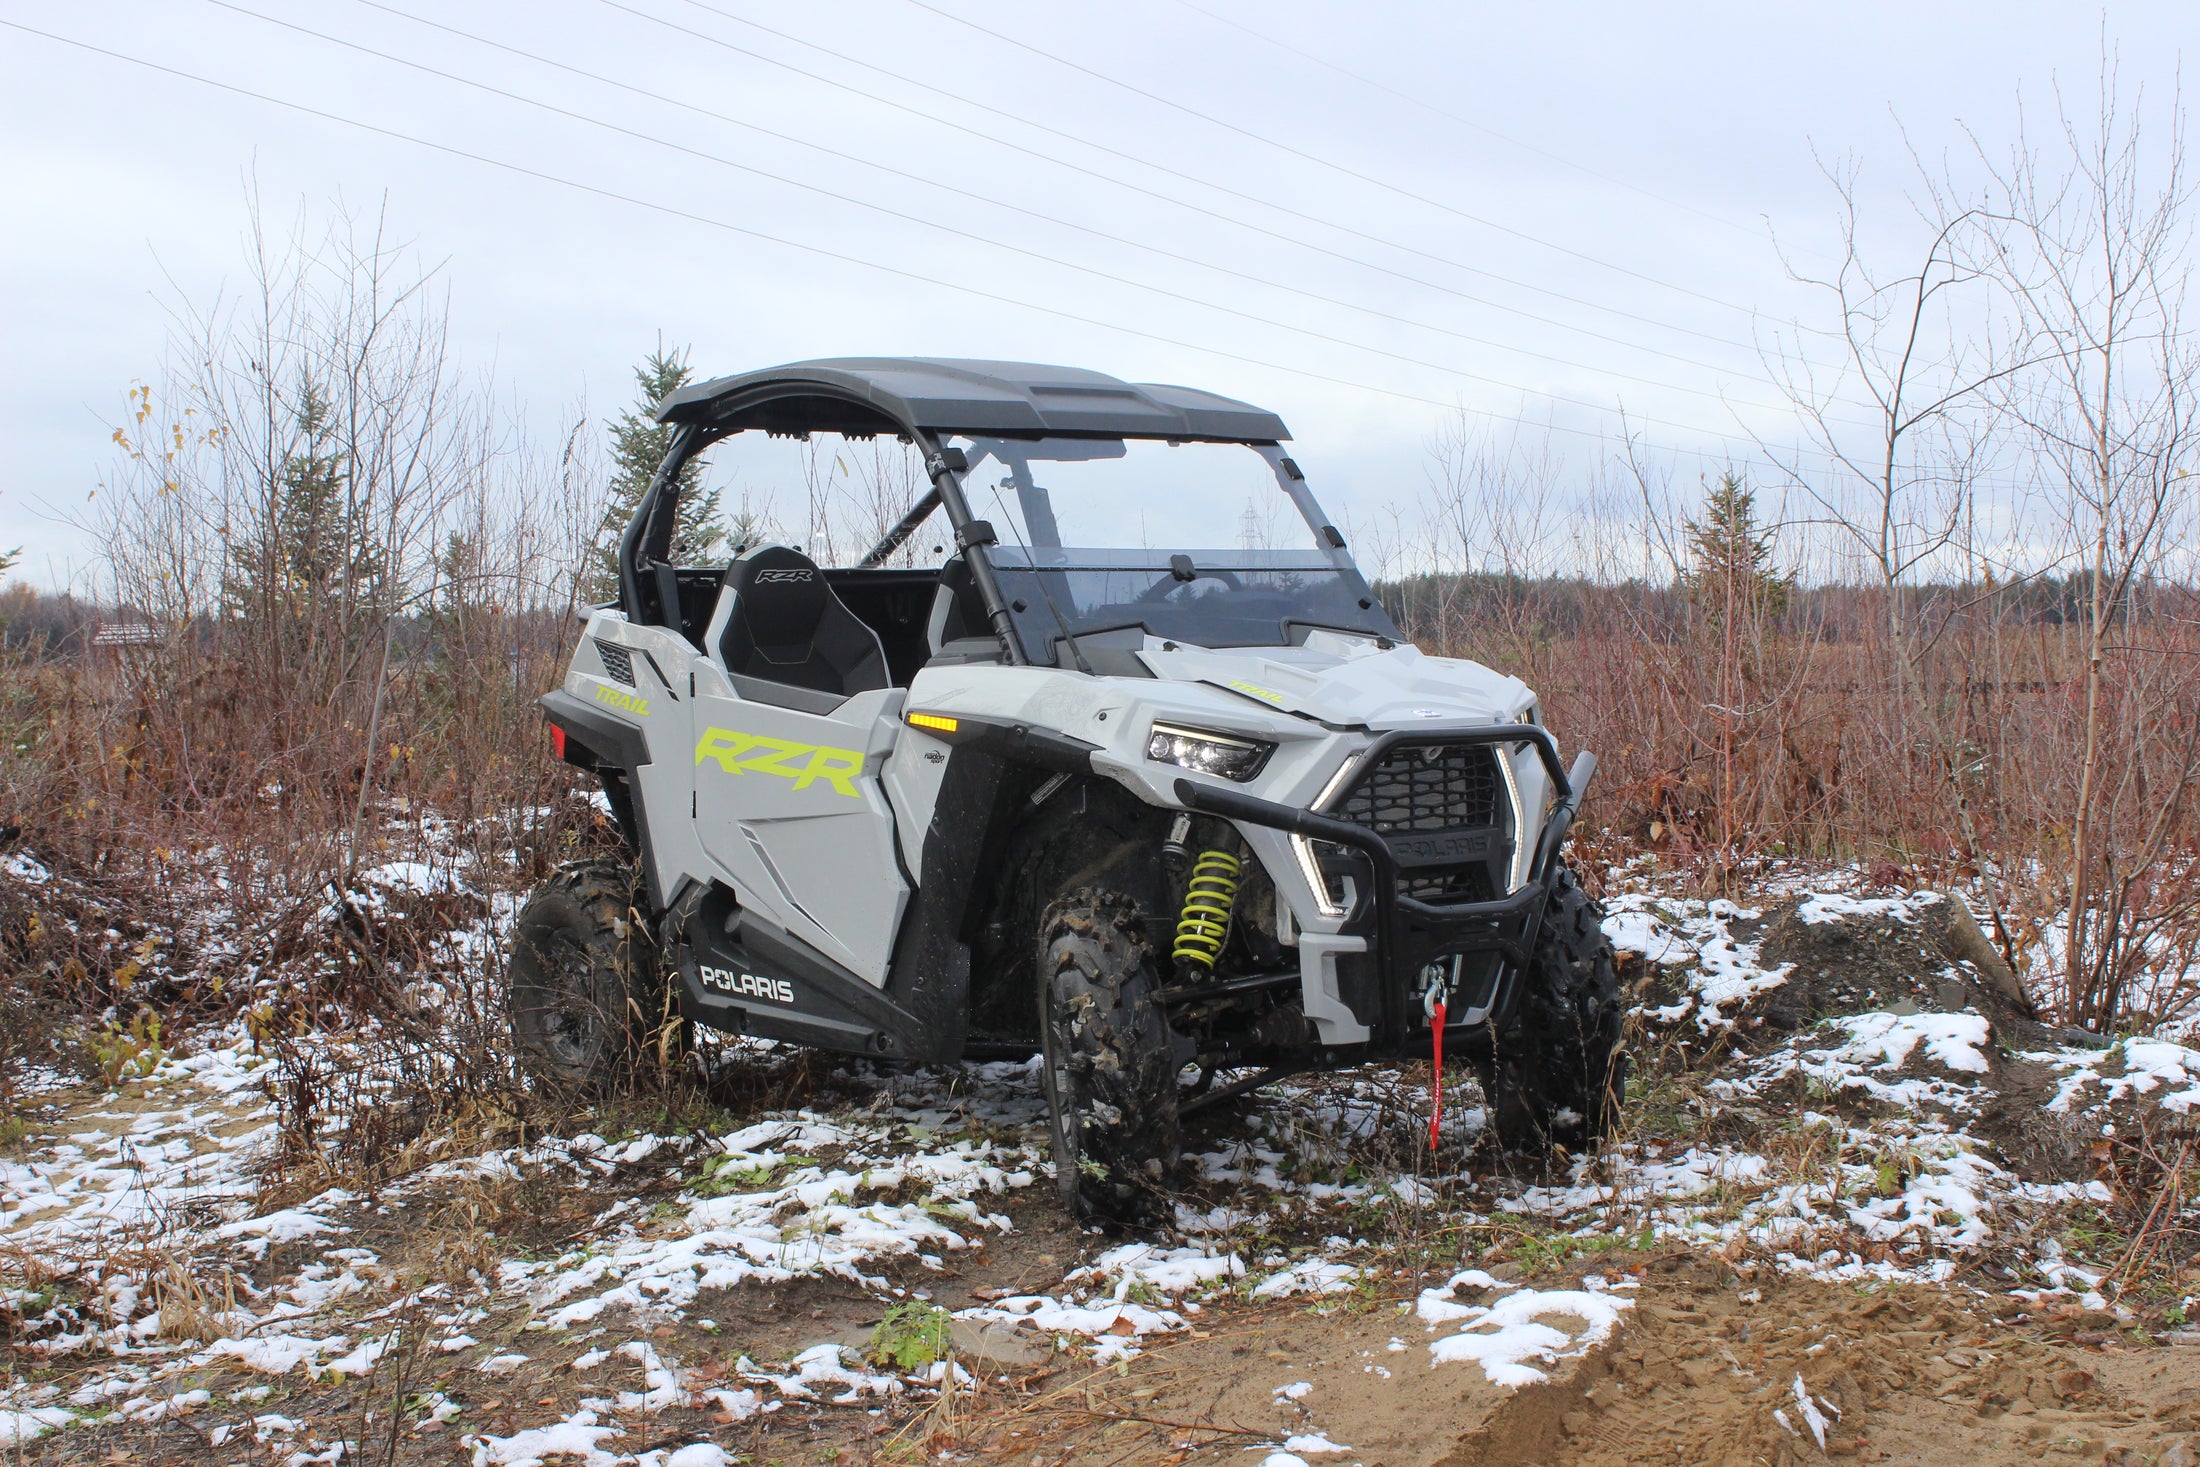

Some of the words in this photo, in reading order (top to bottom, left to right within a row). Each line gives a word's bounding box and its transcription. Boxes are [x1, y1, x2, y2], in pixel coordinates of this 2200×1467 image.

[755, 569, 813, 584] RZR
[596, 684, 651, 716] TRAIL
[1229, 680, 1284, 703] TRAIL
[695, 726, 865, 798] RZR
[700, 965, 794, 1003] POLARIS
